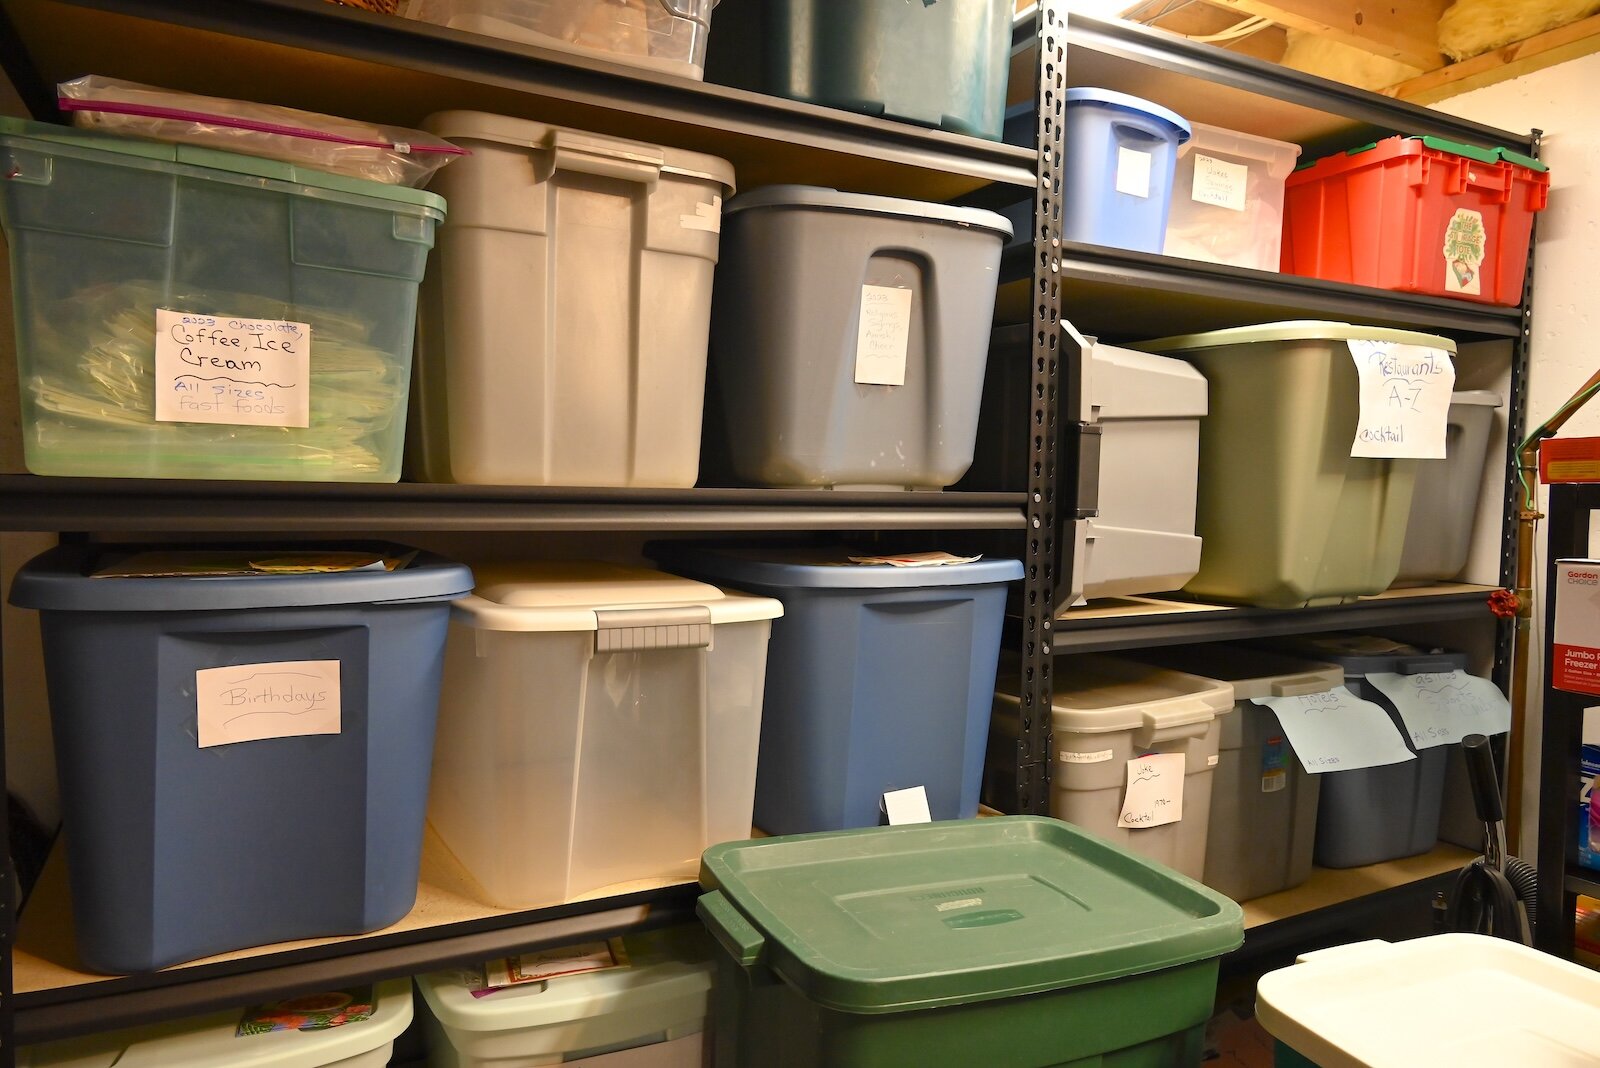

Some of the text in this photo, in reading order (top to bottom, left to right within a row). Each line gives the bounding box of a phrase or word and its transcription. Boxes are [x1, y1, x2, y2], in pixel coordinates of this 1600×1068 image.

[249, 333, 296, 354] Ice
[180, 347, 261, 372] Cream
[1368, 350, 1443, 377] Restaurants
[174, 381, 265, 400] All Sizes
[1389, 385, 1422, 413] A-Z
[1567, 571, 1598, 579] Gordon
[1564, 649, 1595, 660] Jumbo
[1564, 658, 1598, 669] Freezer
[219, 684, 328, 710] Birthdays
[1307, 758, 1319, 768] All
